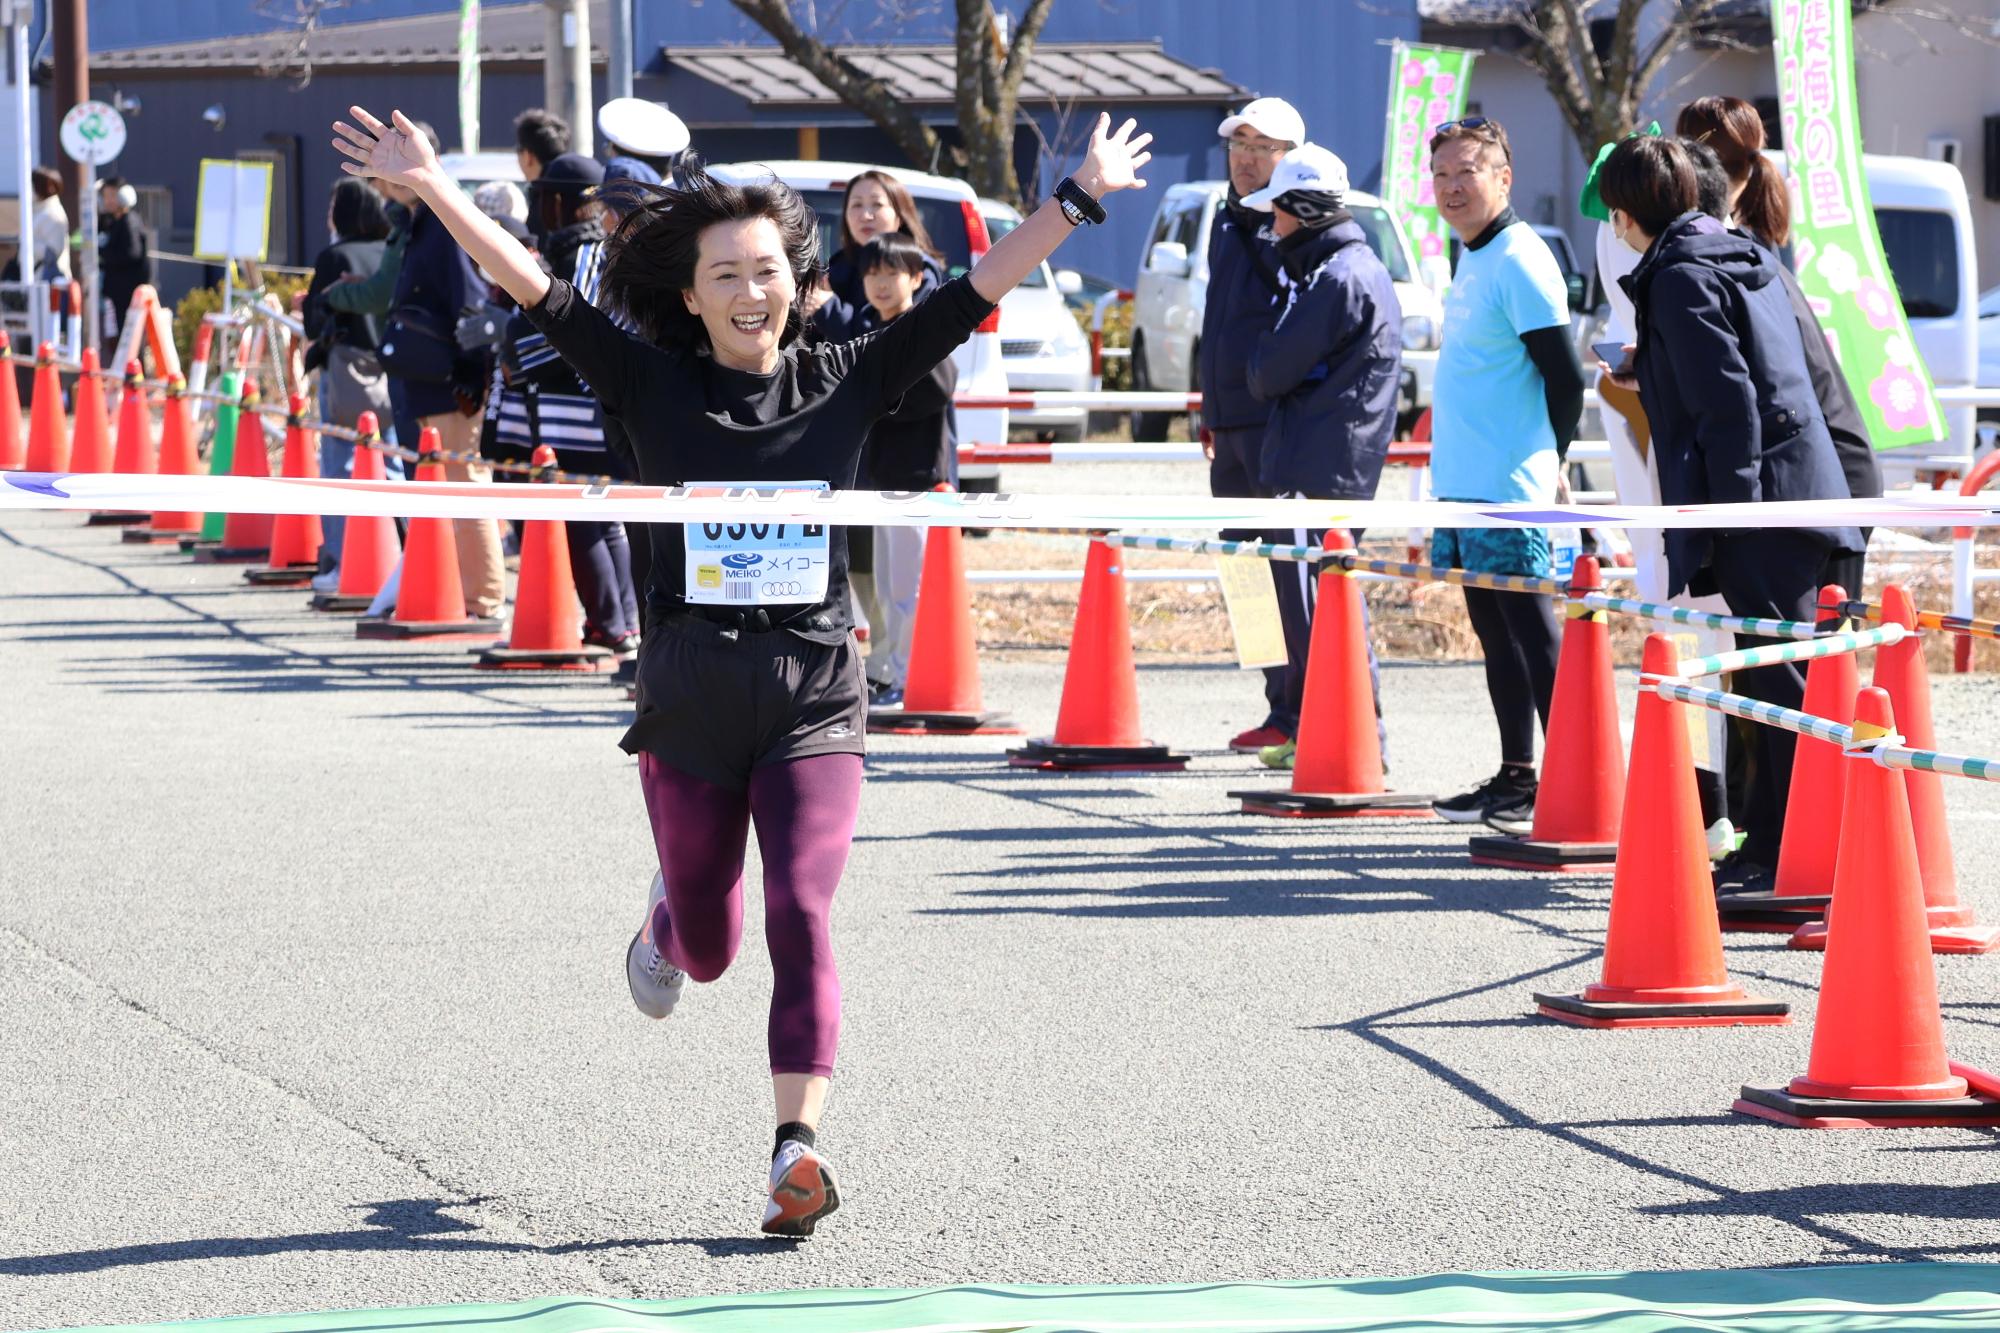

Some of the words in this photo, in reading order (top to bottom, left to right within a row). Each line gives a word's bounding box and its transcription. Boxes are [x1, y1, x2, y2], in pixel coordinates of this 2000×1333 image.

[767, 557, 825, 571] メイコー
[725, 569, 762, 578] MEIKO
